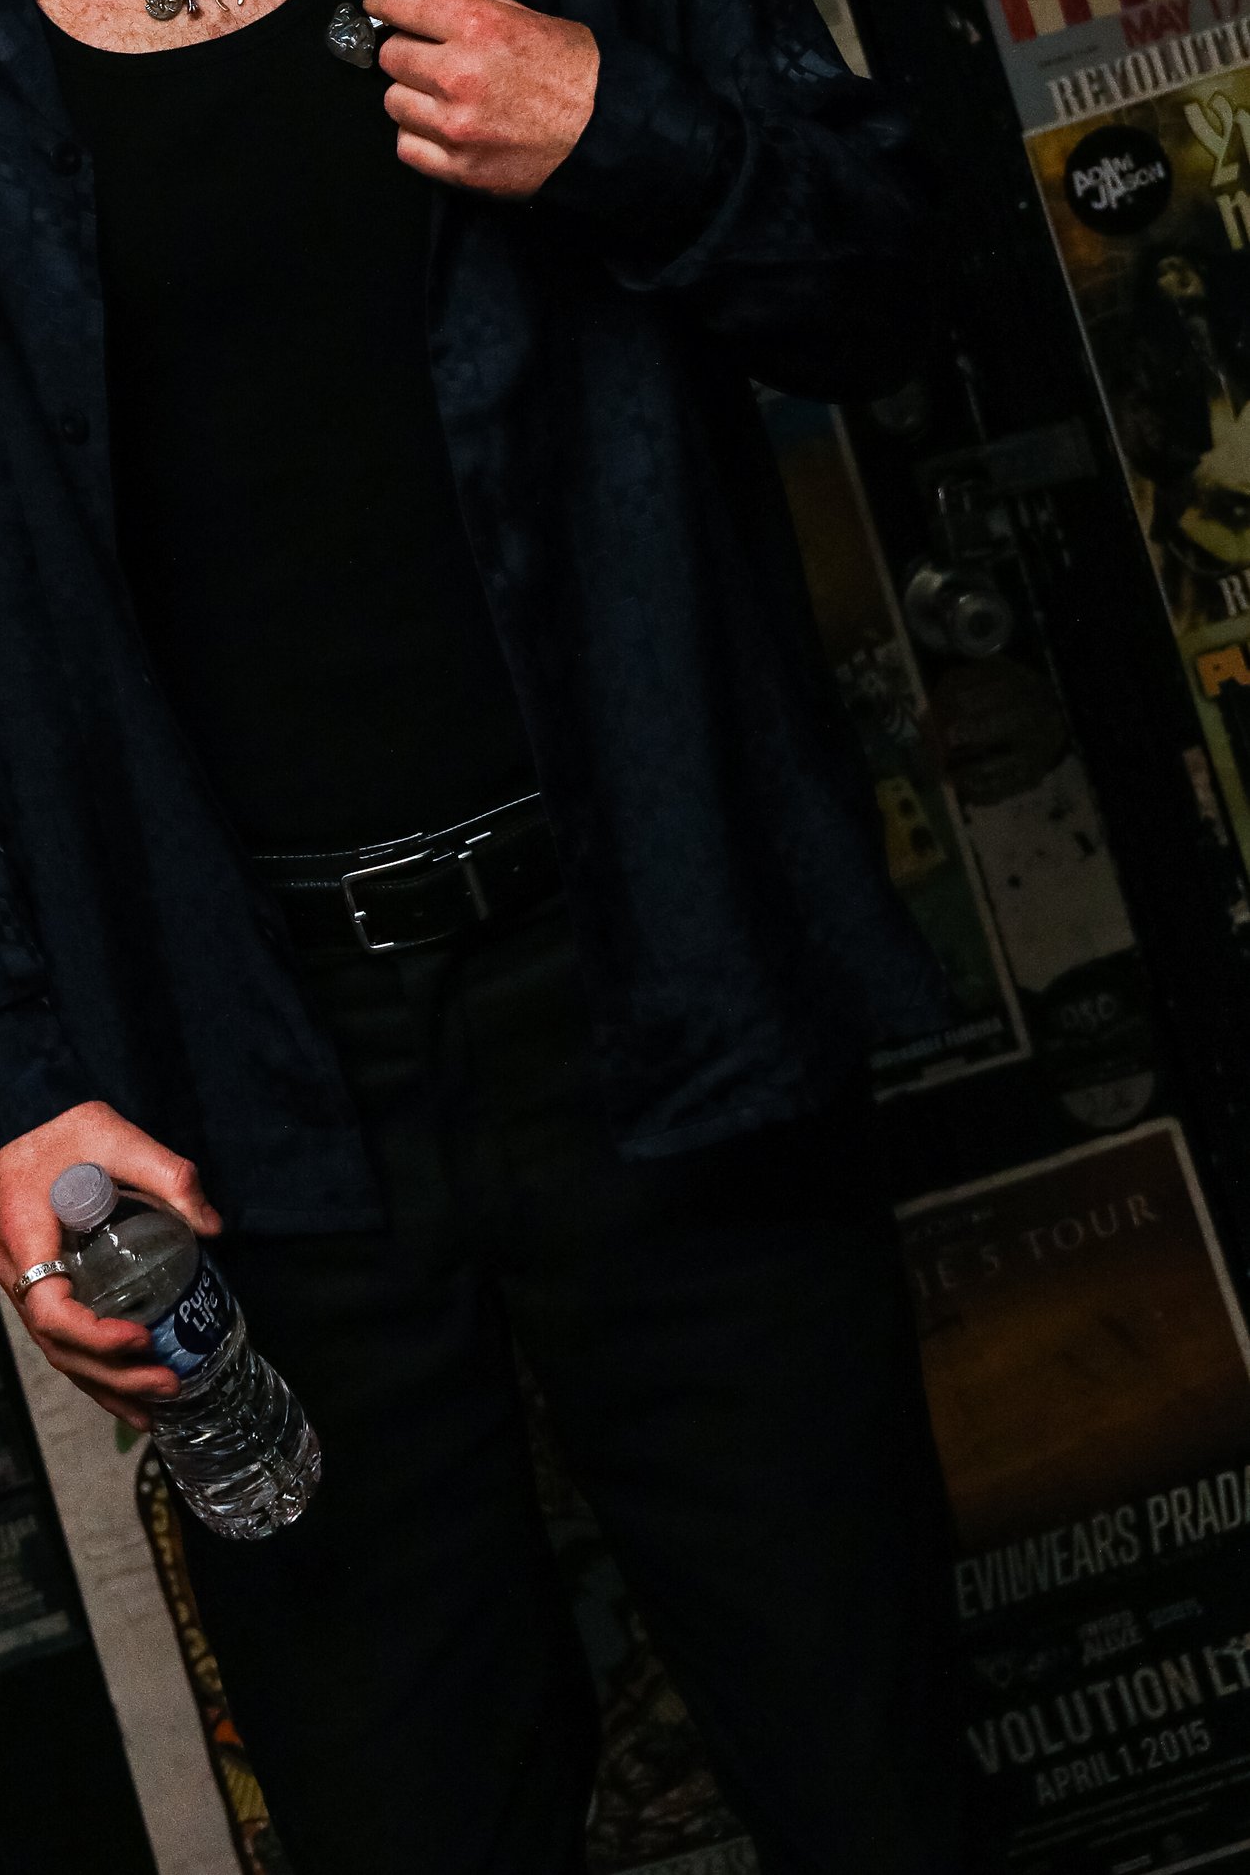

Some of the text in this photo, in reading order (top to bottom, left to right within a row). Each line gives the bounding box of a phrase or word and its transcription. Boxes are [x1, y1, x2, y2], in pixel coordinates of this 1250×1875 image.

[1119, 0, 1194, 49] MAY
[1072, 152, 1135, 200] ADAM
[1020, 1192, 1161, 1263] TOUR
[178, 1268, 212, 1325] Pure
[192, 1289, 220, 1334] Life
[954, 1544, 1031, 1621] EVIL
[1024, 1503, 1142, 1595] WEARS
[966, 1650, 1205, 1776] VOLUTION
[1034, 1751, 1121, 1807] APRIL
